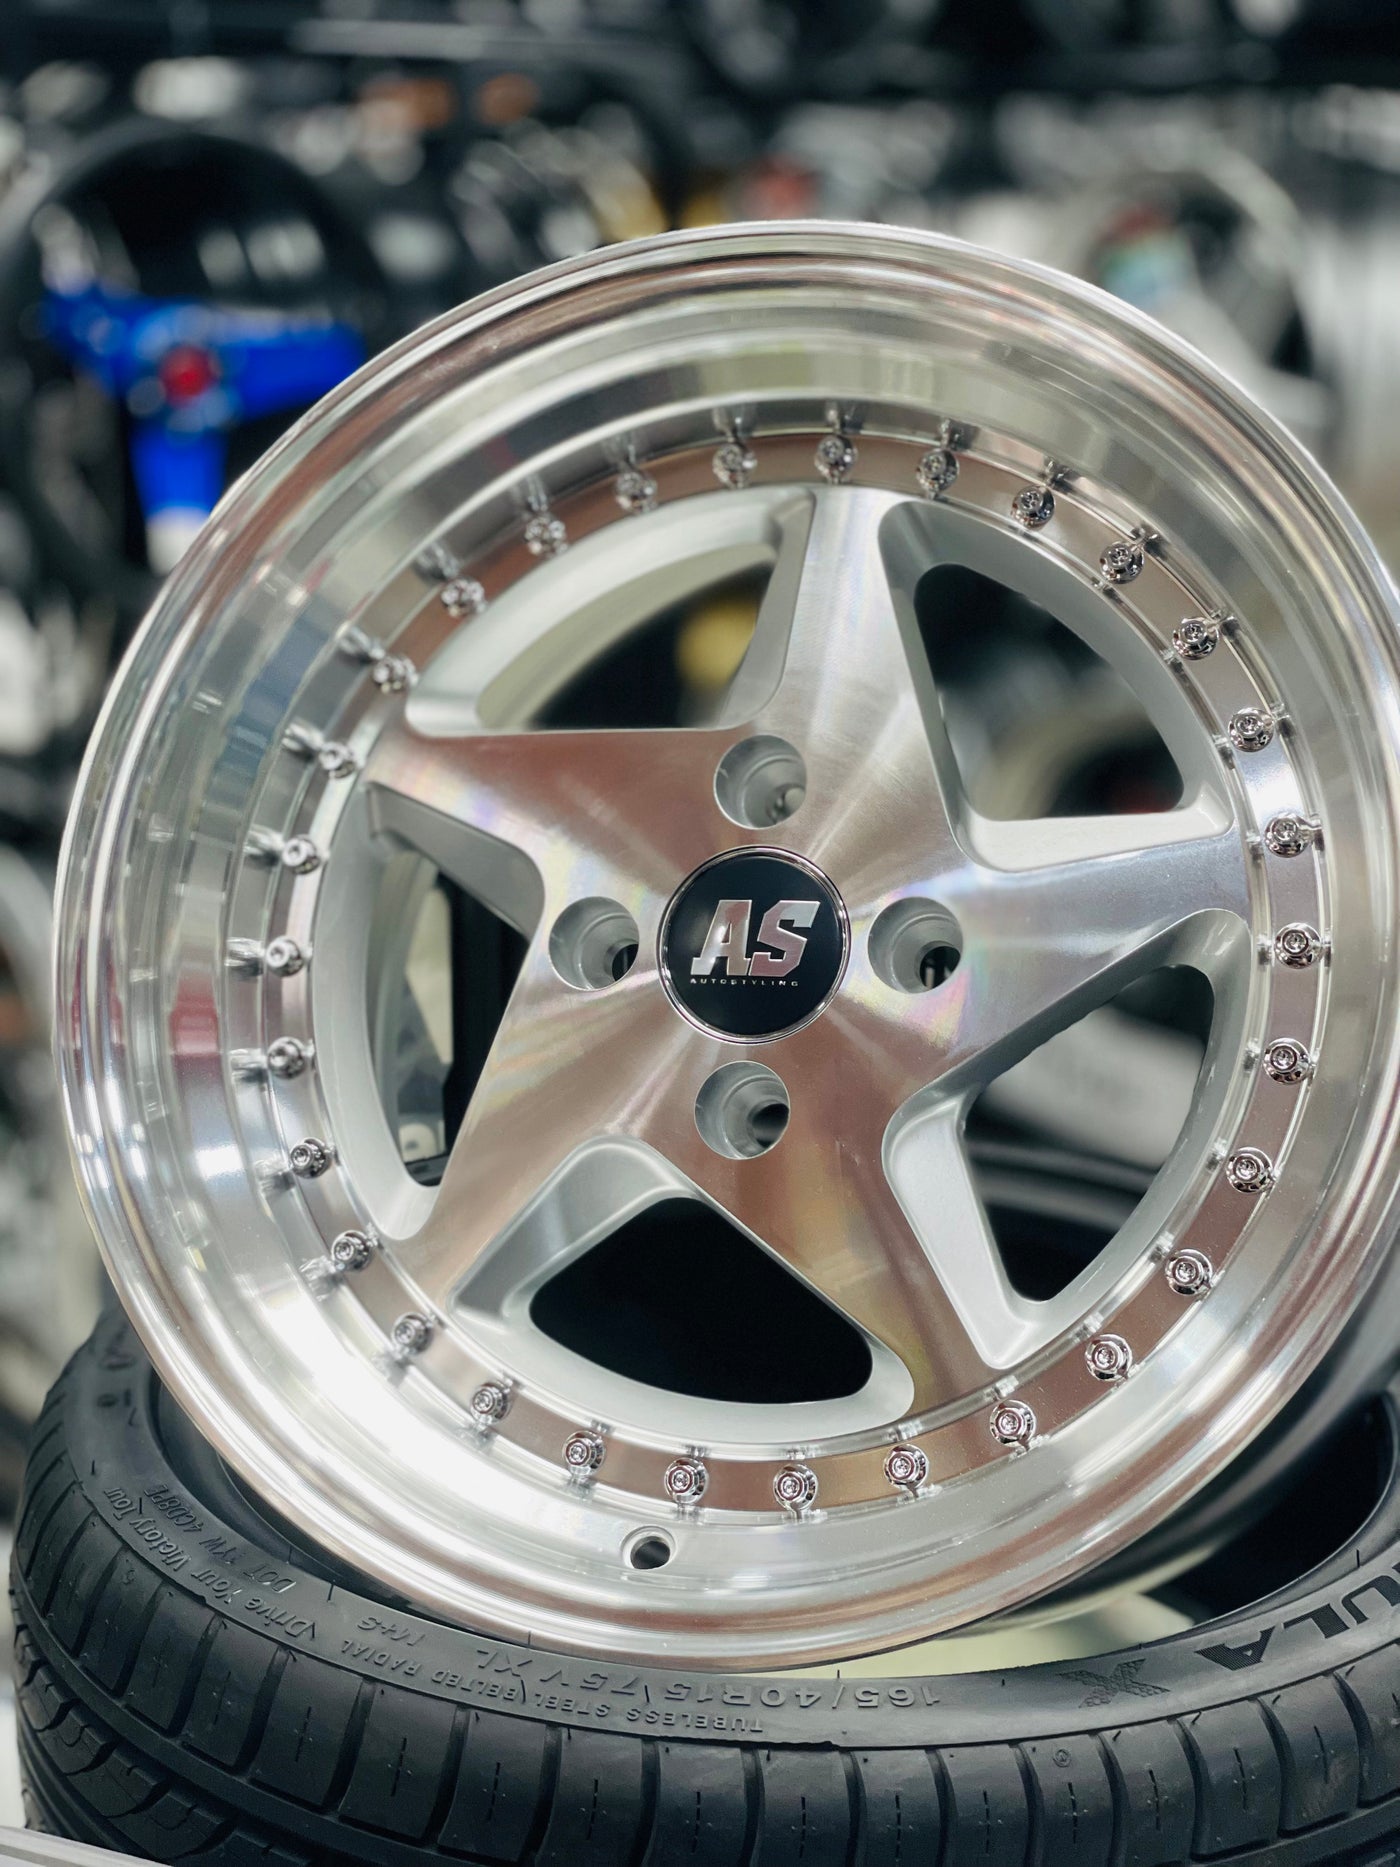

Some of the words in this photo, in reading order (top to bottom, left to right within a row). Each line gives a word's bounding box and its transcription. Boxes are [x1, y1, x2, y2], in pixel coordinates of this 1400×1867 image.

[690, 899, 821, 977] AS
[690, 978, 799, 988] AUTOSTYLING
[104, 1487, 138, 1521] Tour
[129, 1517, 192, 1573] Victory
[191, 1569, 242, 1605] Your
[243, 1564, 297, 1594] DOT
[245, 1597, 313, 1637] Drive
[357, 1616, 425, 1647] M+S
[1194, 1562, 1400, 1671] ULA
[341, 1639, 423, 1677] RADIAL
[476, 1650, 533, 1677] XL
[431, 1669, 520, 1702] BELTED
[664, 1682, 941, 1709] 165/40R15
[535, 1693, 611, 1718] STEEL
[626, 1706, 763, 1733] TUBELESS
